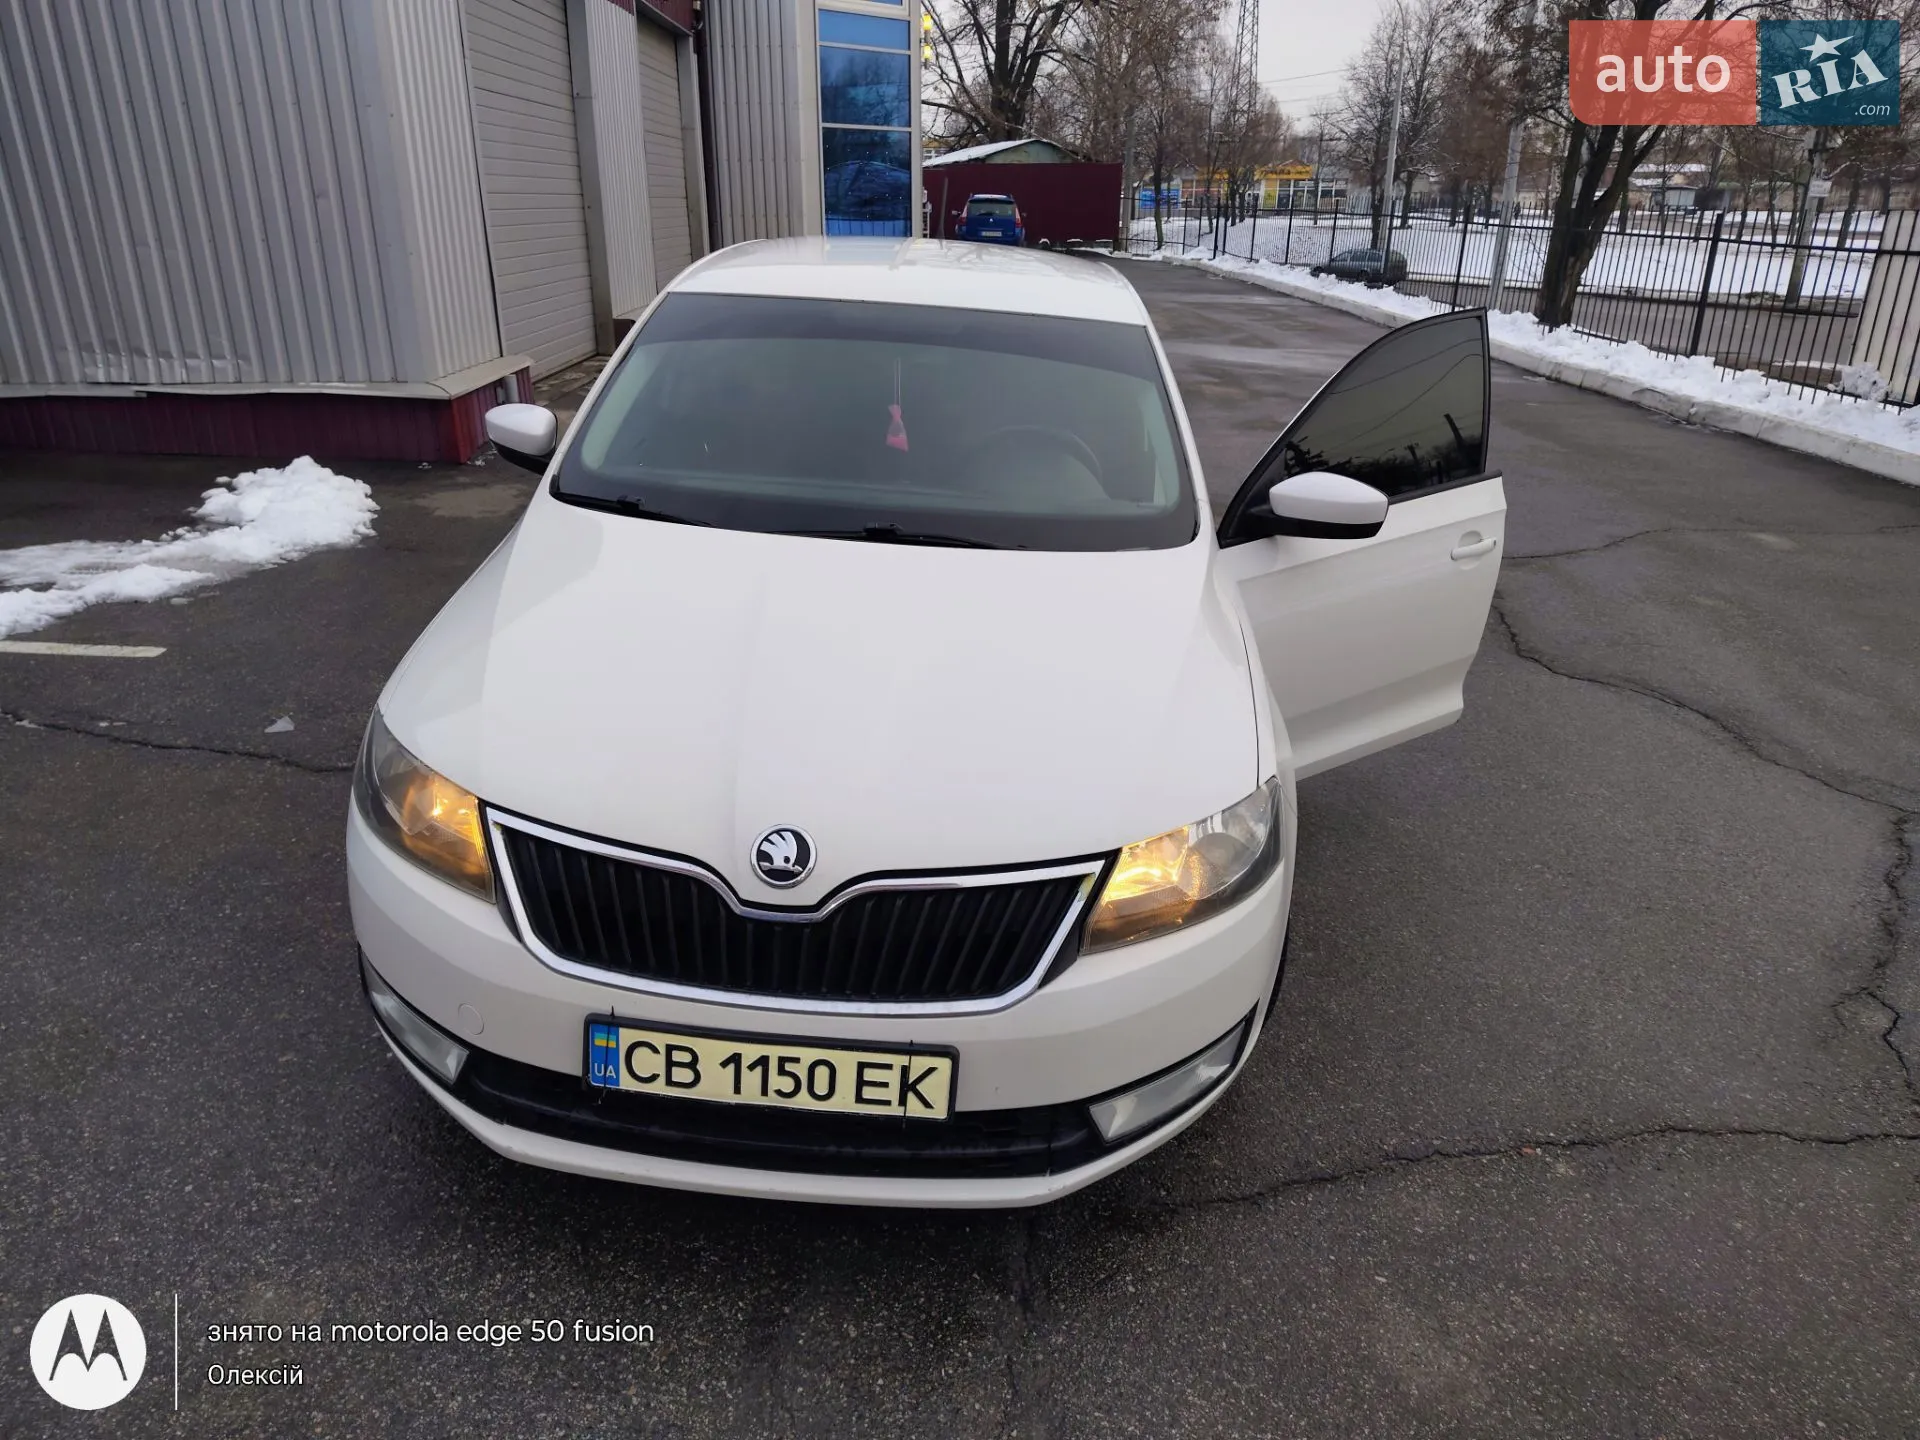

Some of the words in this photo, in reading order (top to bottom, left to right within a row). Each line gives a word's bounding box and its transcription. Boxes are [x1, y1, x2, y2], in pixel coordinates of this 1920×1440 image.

[594, 1062, 617, 1079] UA
[624, 1040, 702, 1089] CB
[719, 1052, 837, 1102] 1150
[854, 1060, 939, 1110] EK
